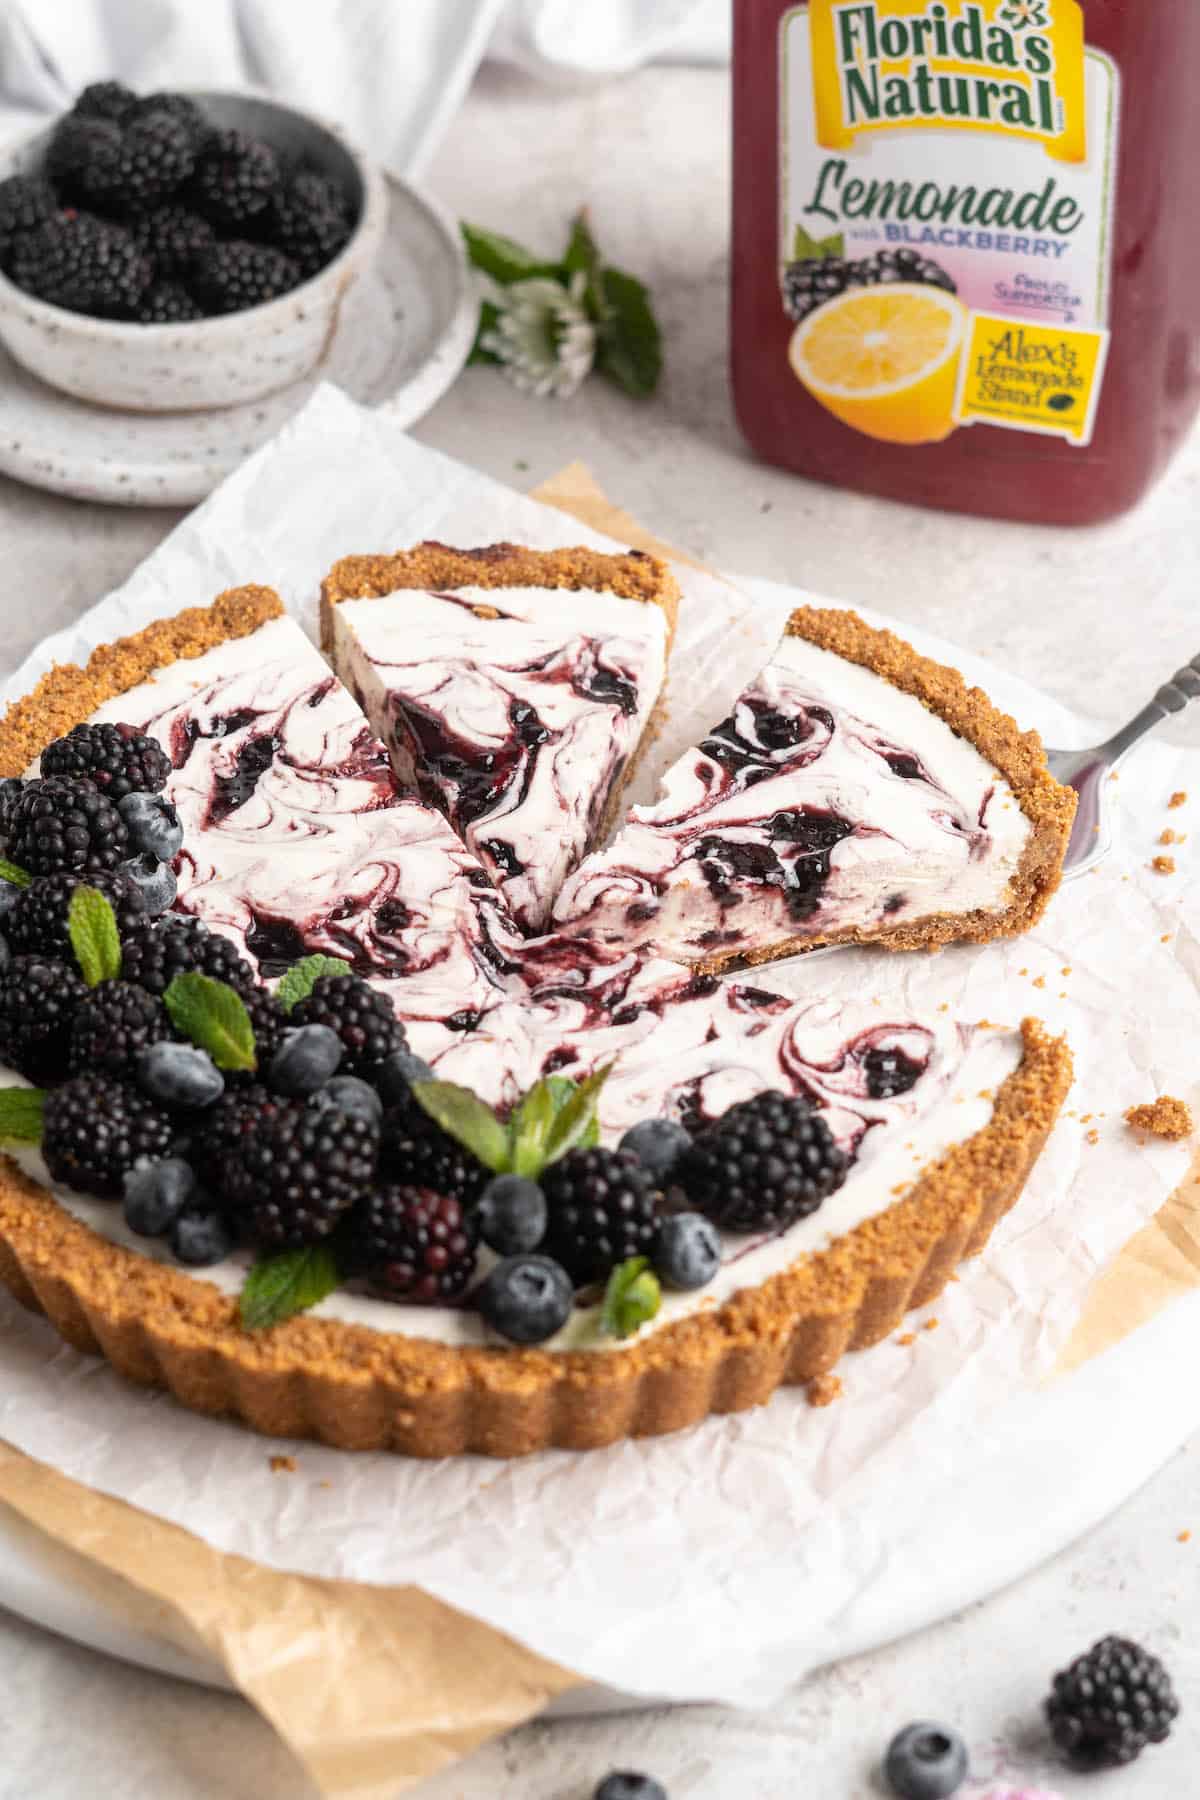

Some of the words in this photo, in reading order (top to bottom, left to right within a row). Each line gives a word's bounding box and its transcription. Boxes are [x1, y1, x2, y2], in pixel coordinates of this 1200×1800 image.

[845, 64, 1054, 132] Natural
[803, 159, 1085, 234] Lemonade
[884, 224, 1071, 259] BLACKBERRY
